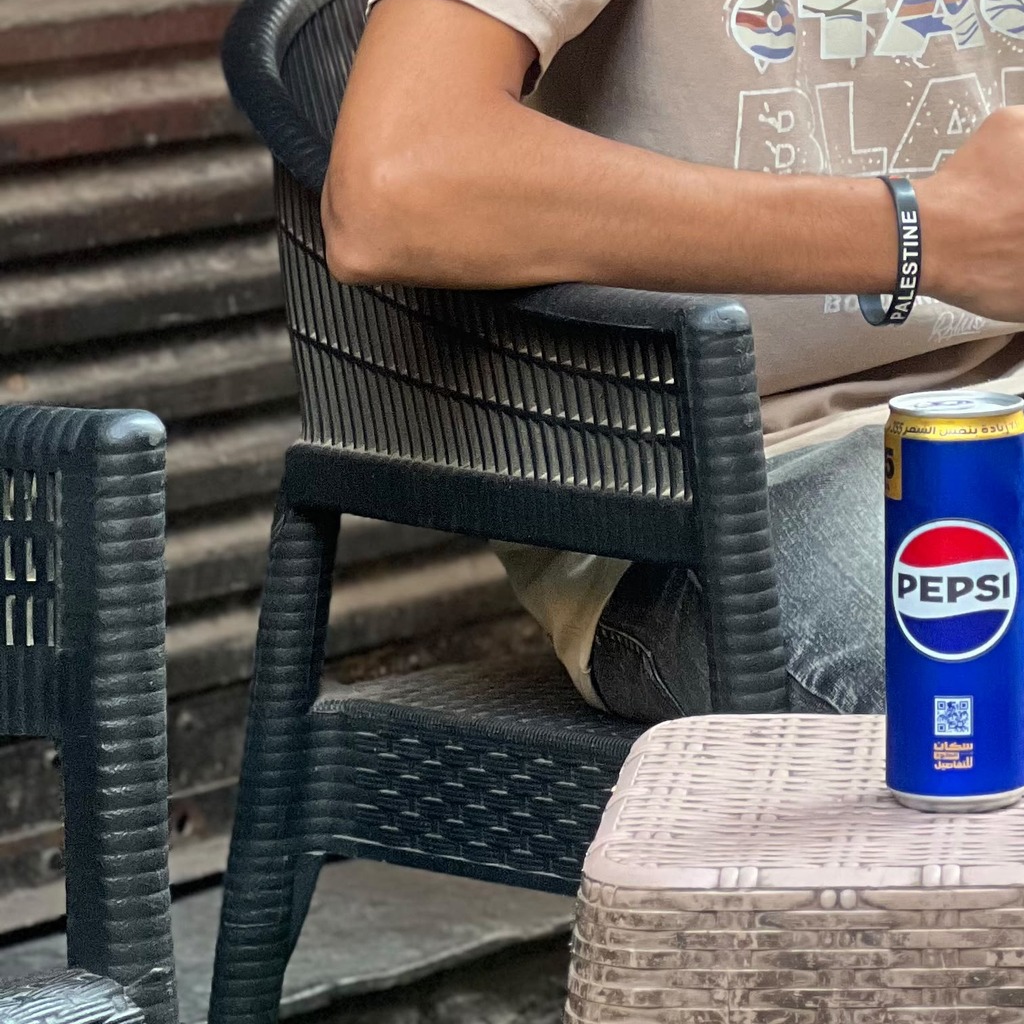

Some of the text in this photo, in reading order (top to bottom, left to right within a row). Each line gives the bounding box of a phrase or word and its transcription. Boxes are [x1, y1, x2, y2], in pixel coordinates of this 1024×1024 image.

[890, 210, 919, 321] PALESTINE
[938, 426, 978, 437] بنفس
[897, 573, 1010, 603] PEPSI
